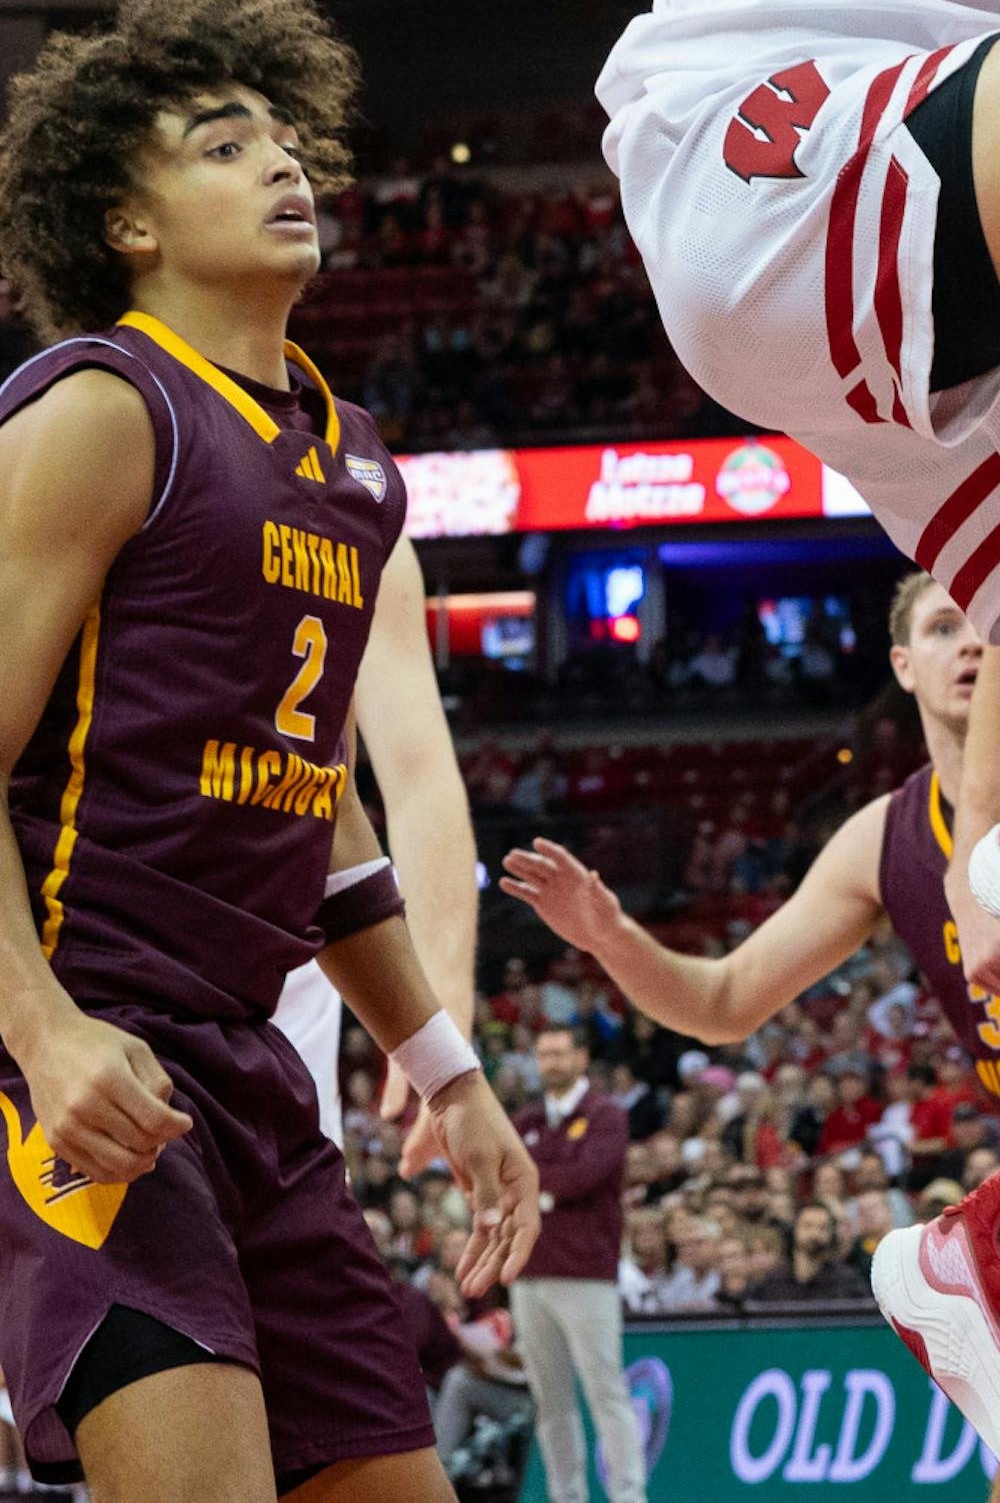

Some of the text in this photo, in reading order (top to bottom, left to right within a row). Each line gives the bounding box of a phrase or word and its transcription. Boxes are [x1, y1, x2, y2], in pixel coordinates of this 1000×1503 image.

[262, 520, 363, 609] CENTRAL
[275, 615, 327, 742] 2
[729, 1367, 896, 1484] OLD
